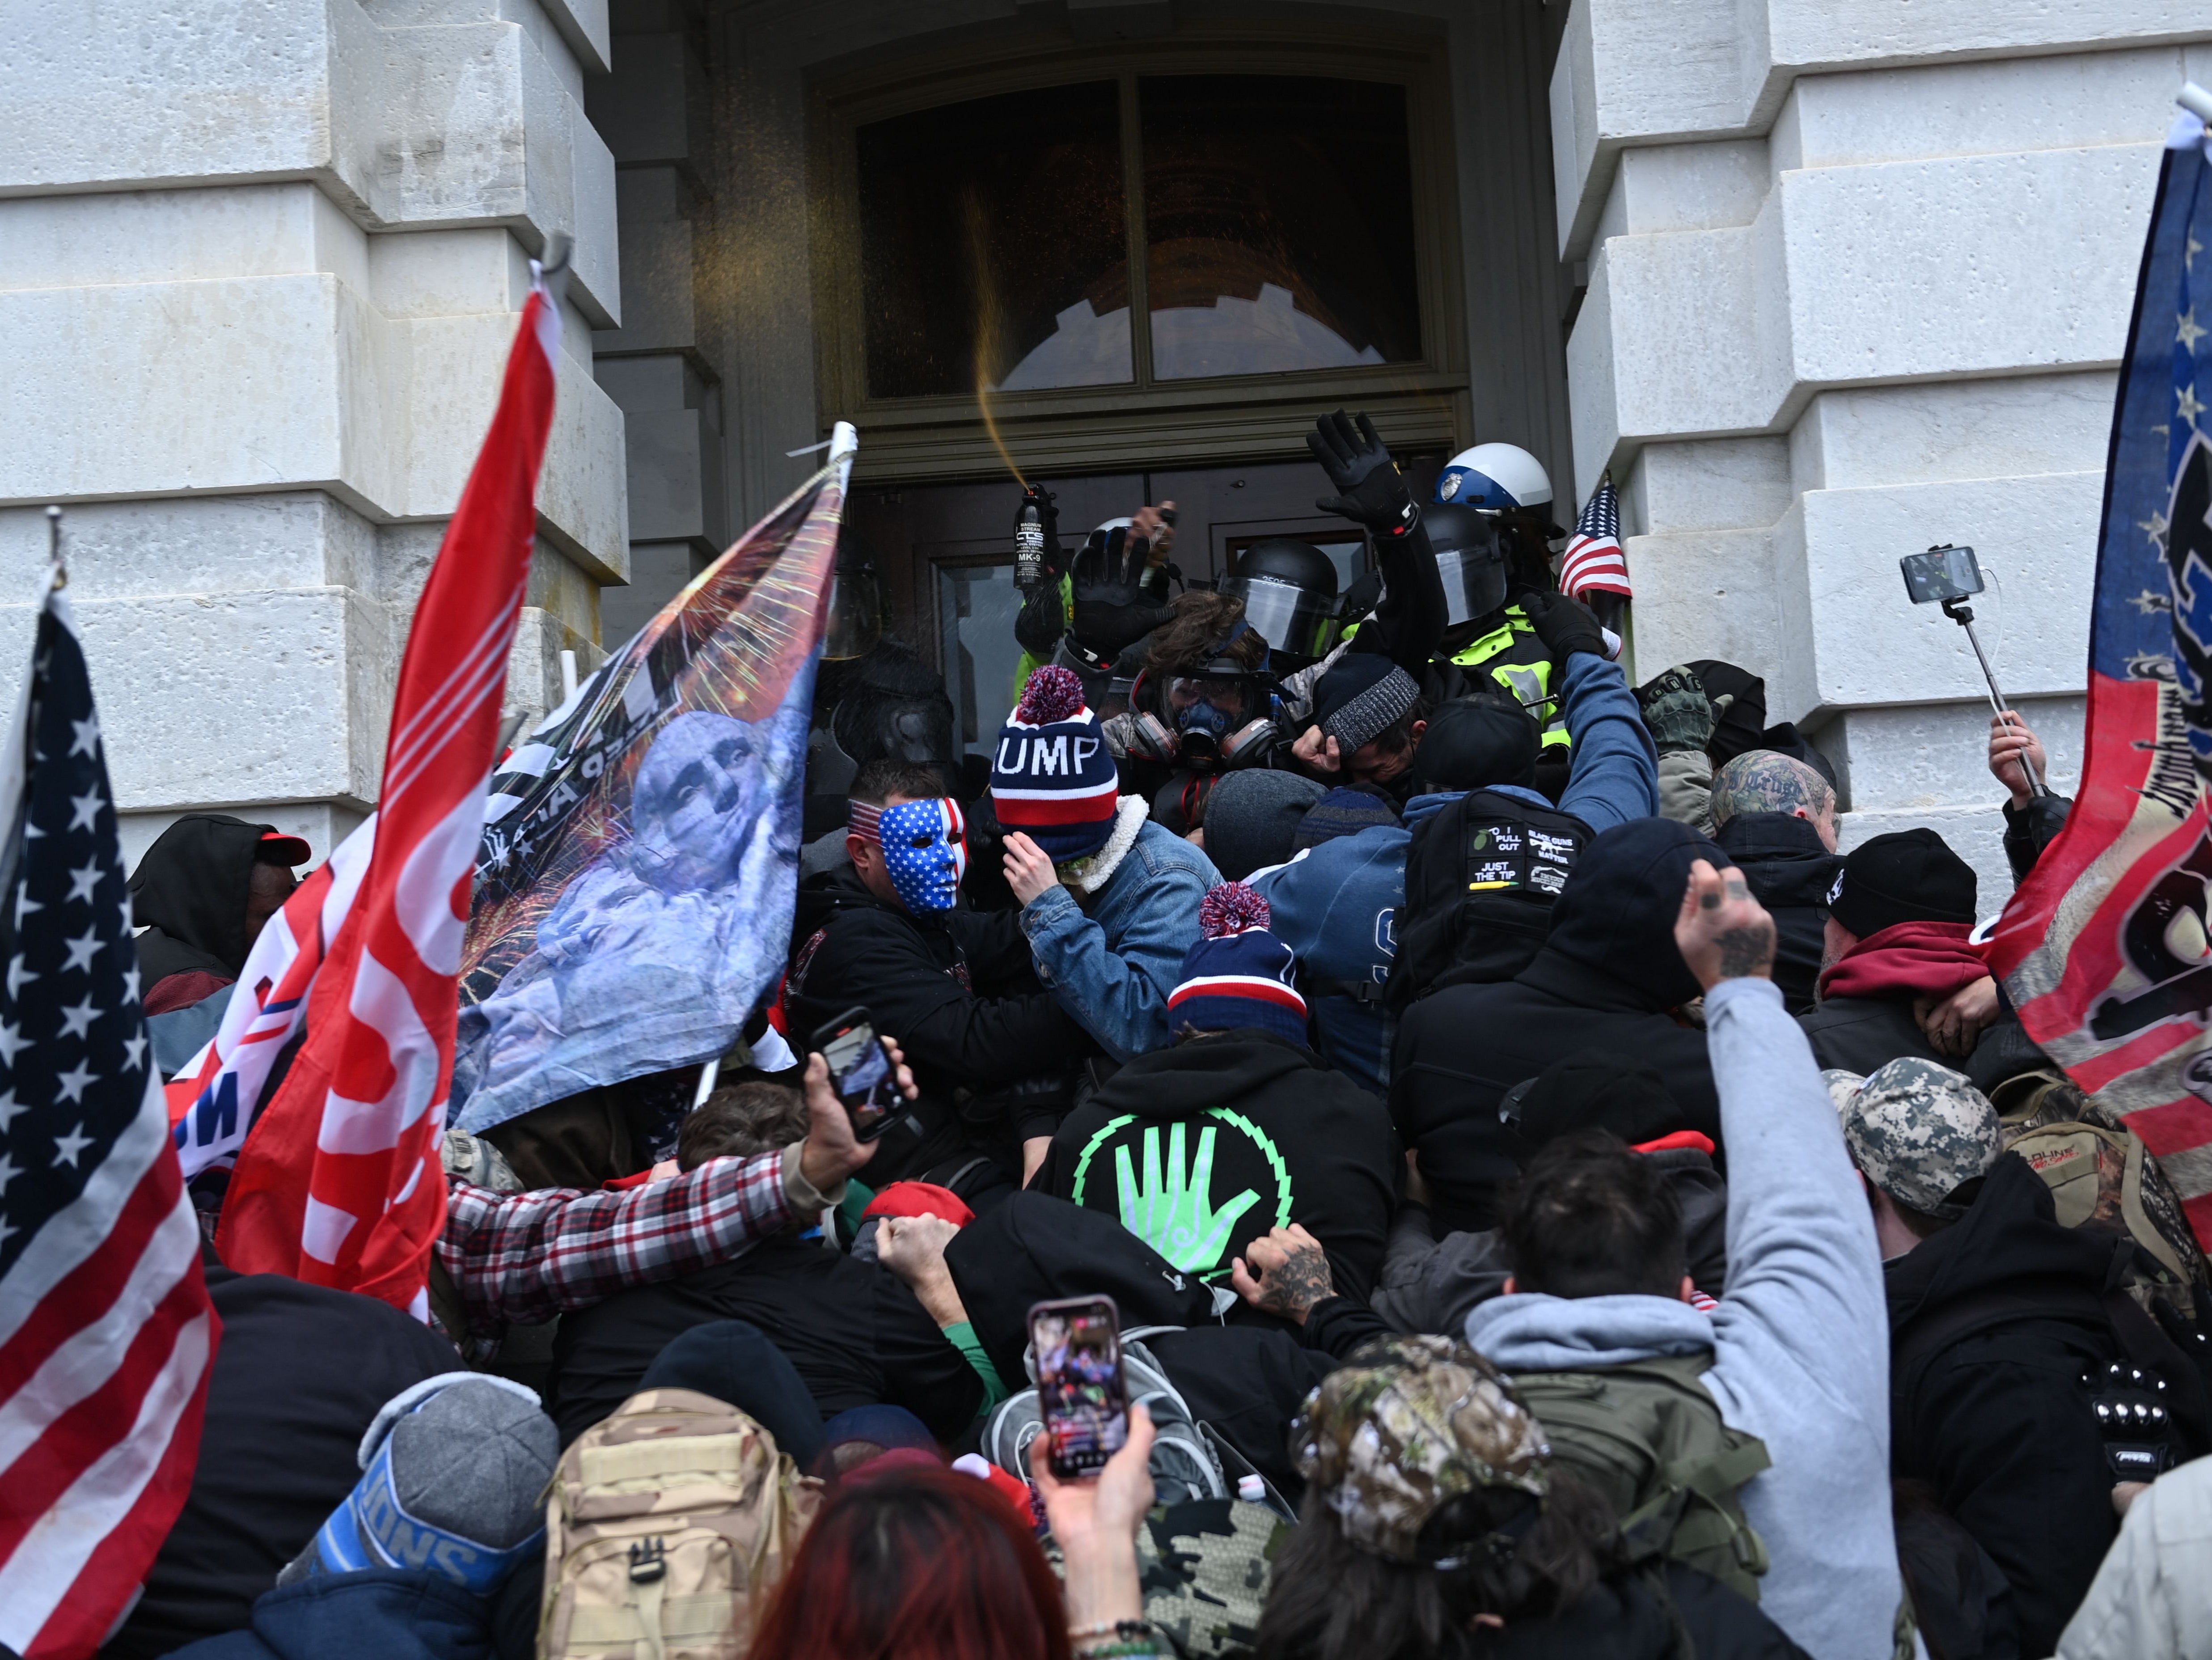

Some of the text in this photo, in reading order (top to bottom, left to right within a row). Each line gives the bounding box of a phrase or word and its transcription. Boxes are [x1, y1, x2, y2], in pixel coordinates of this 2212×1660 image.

[1016, 531, 1045, 541] CTS
[1019, 553, 1041, 562] MK-9
[992, 735, 1099, 775] UMP
[1528, 830, 1573, 846] BLACK GUNS
[1538, 850, 1569, 864] MATTER
[1481, 862, 1509, 872] JUST
[1475, 870, 1516, 881] THE TIP
[362, 1469, 478, 1587] IONS
